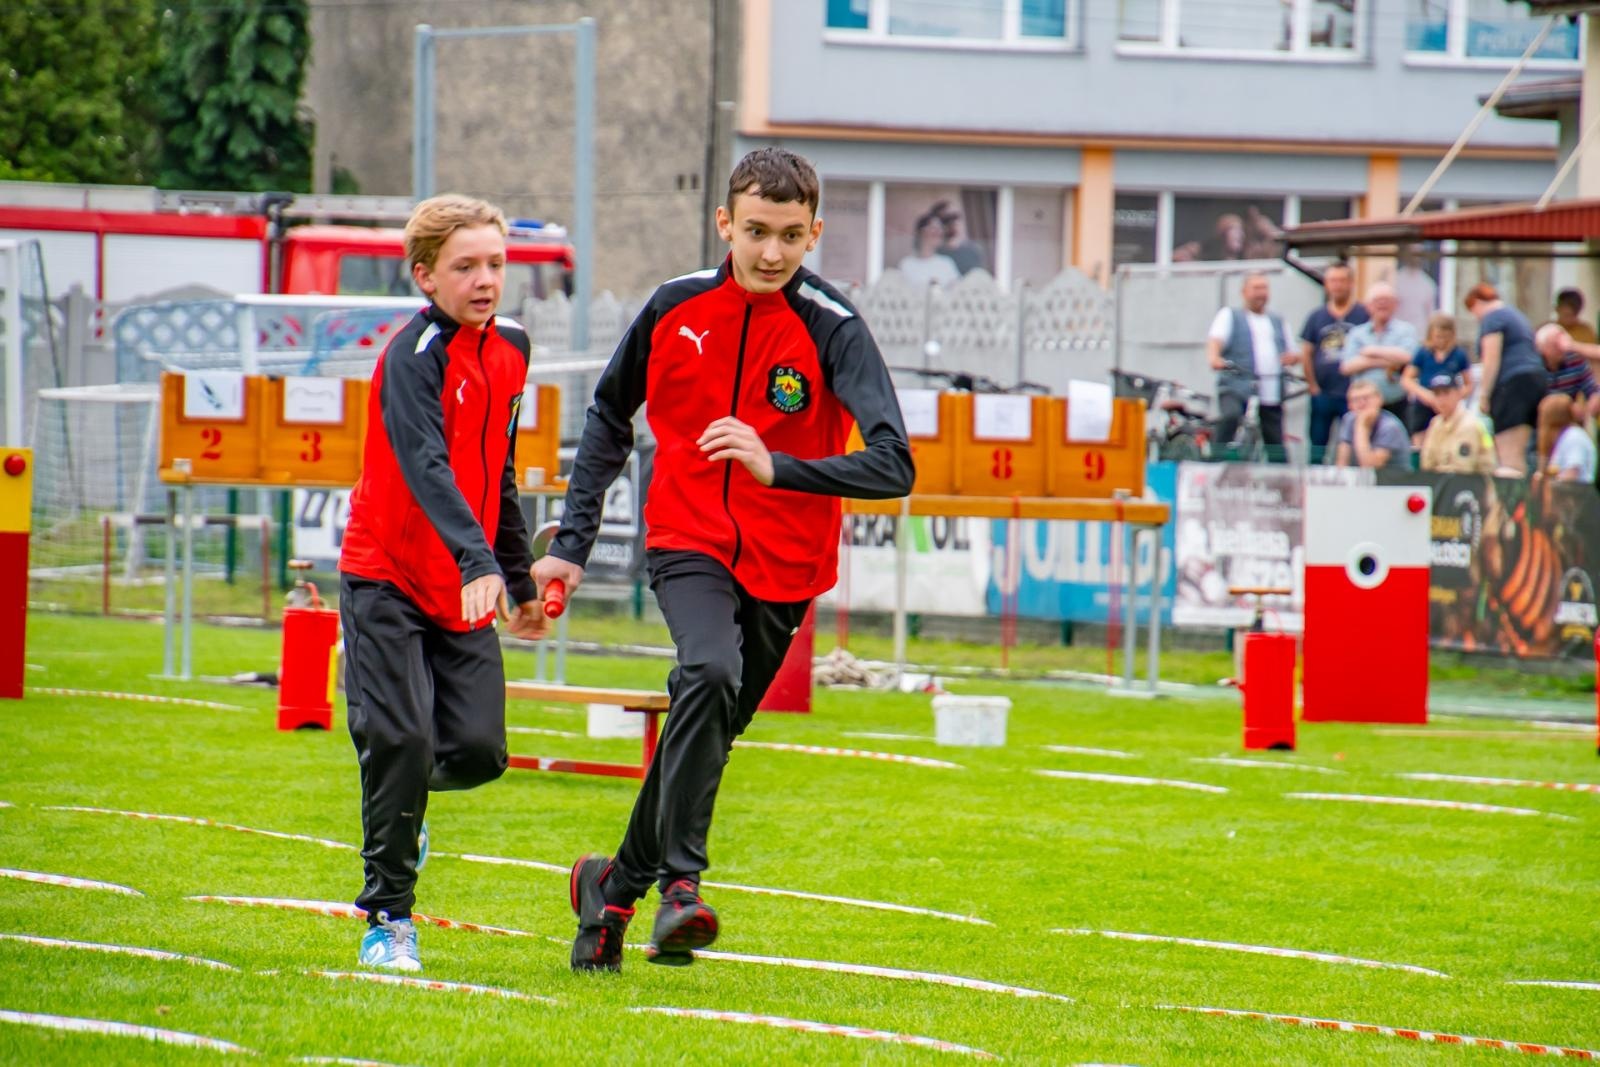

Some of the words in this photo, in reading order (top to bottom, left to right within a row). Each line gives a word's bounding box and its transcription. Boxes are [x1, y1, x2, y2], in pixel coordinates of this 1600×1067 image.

[201, 428, 222, 461] 2
[300, 431, 323, 463] 3
[992, 447, 1013, 480] 8
[1083, 451, 1106, 481] 9
